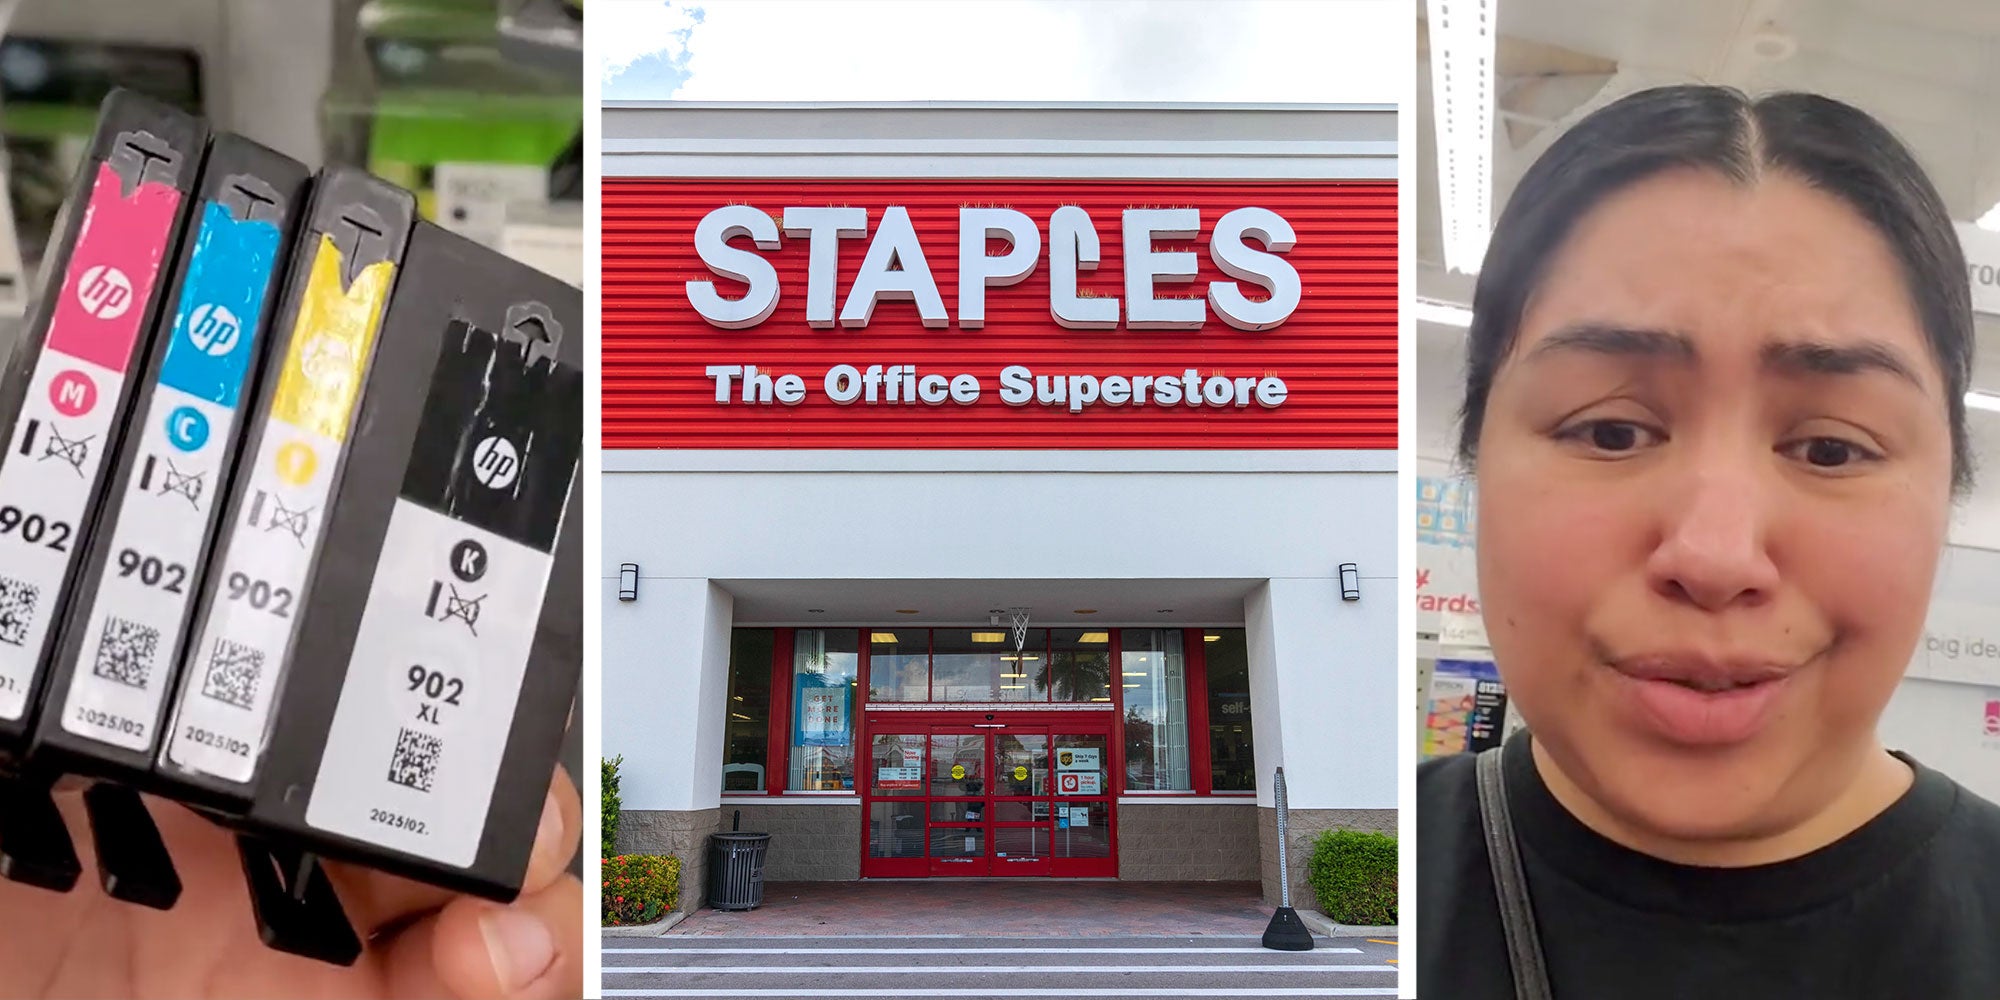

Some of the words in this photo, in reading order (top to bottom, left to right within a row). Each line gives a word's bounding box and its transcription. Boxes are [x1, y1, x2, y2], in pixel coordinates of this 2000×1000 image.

[685, 203, 1302, 331] STAPLES
[80, 265, 128, 318] hp
[192, 303, 238, 356] hp
[60, 381, 85, 410] M
[705, 365, 806, 405] The
[824, 363, 981, 406] Office
[999, 364, 1289, 413] Superstore
[177, 419, 194, 444] C
[476, 438, 516, 488] hp
[0, 505, 71, 552] 902
[118, 547, 187, 594] 902
[461, 548, 478, 572] K
[228, 571, 294, 618] 902
[1417, 593, 1480, 613] ards
[1965, 638, 2000, 660] ide
[408, 664, 464, 706] 902
[416, 703, 440, 725] XL
[1221, 702, 1251, 713] self-
